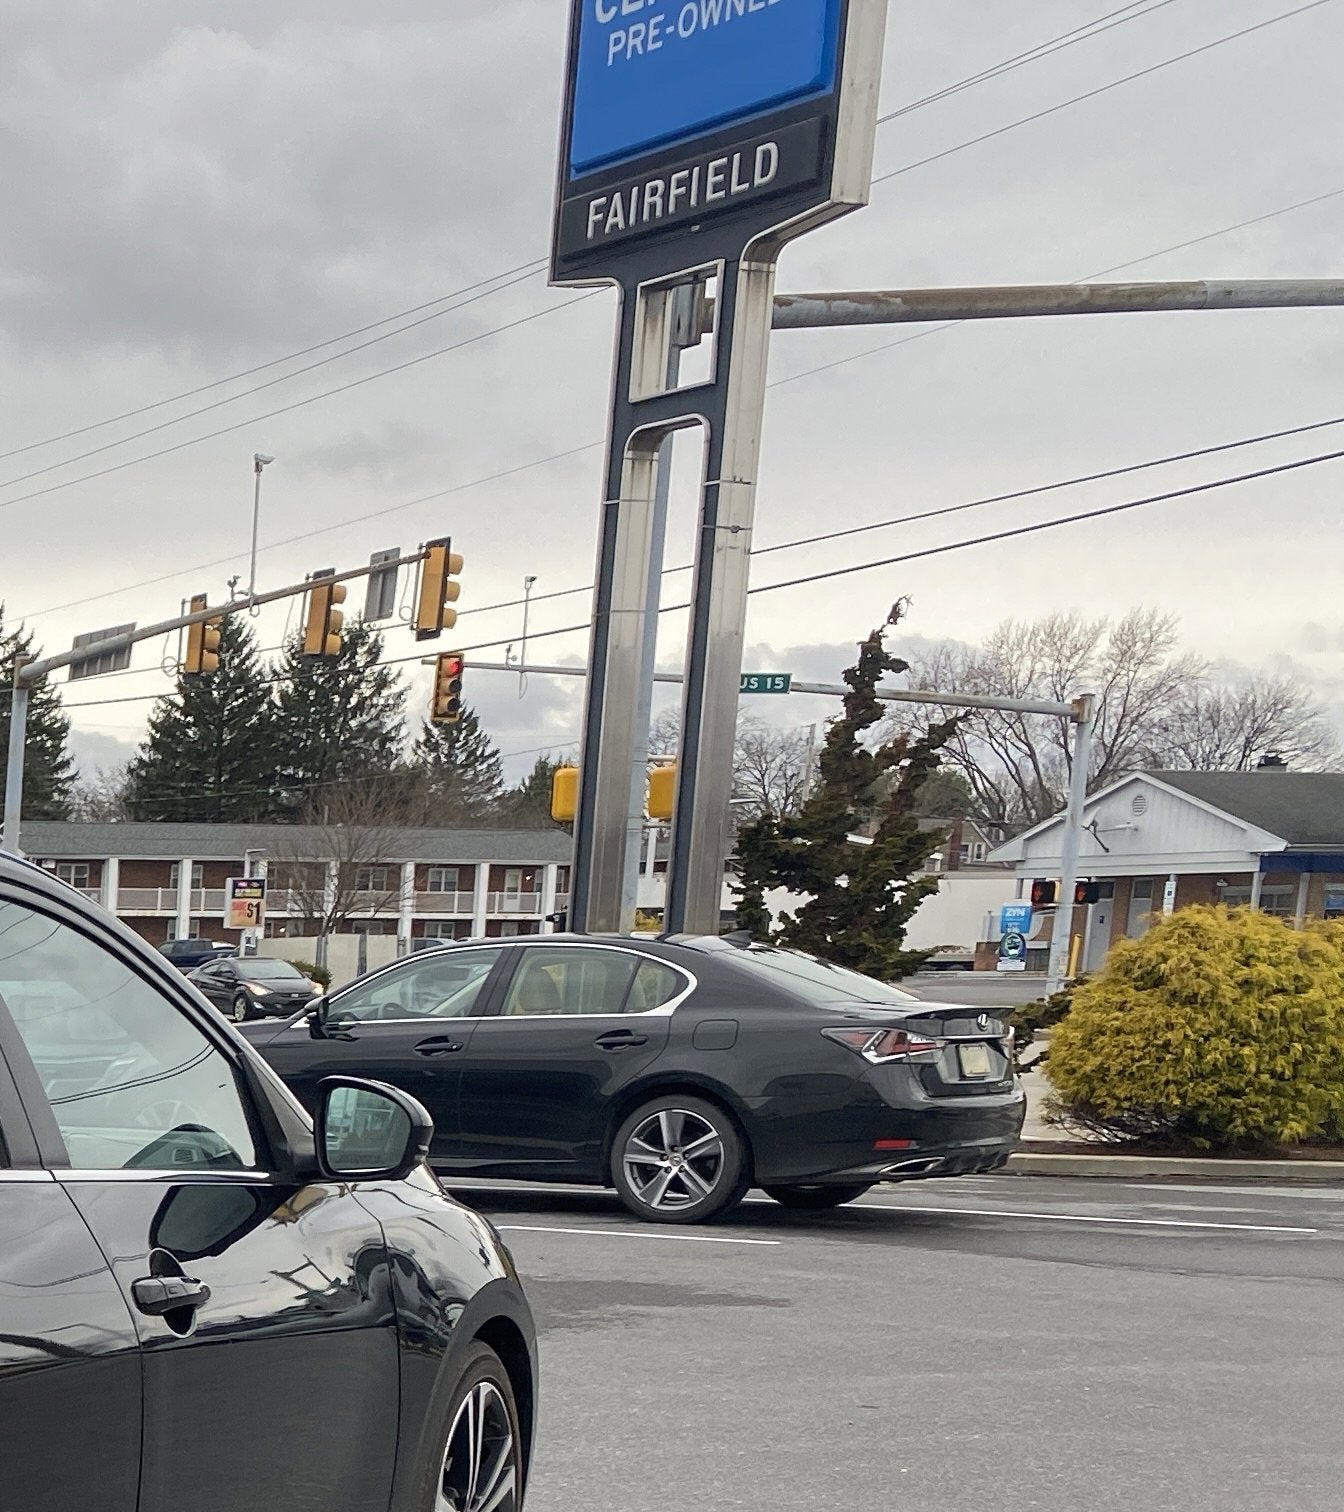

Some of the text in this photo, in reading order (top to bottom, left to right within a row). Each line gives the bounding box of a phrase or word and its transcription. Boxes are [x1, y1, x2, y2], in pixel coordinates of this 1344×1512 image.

[607, 0, 783, 67] PRE-OWN
[586, 141, 779, 239] FAIRFIELD
[766, 677, 784, 689] 15
